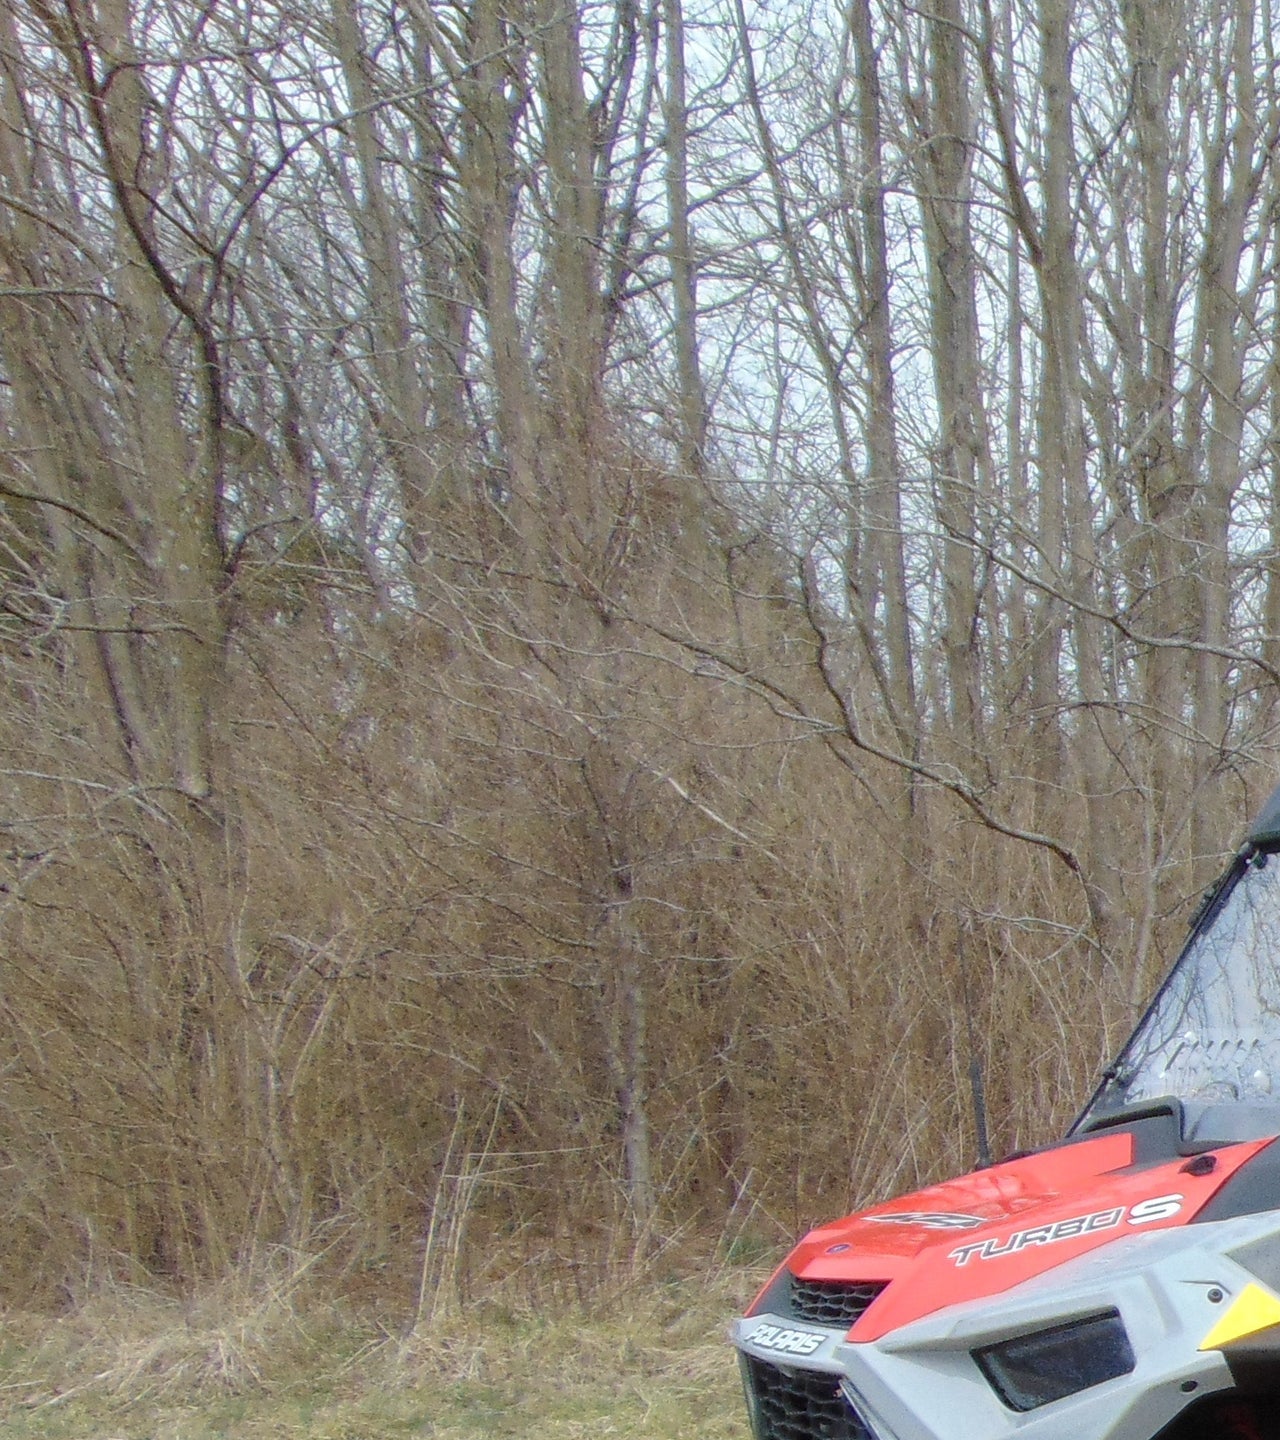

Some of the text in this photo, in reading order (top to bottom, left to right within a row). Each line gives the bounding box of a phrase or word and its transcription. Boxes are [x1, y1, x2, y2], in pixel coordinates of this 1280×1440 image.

[947, 1192, 1185, 1268] TURBO S
[744, 1324, 828, 1355] POLARIS
